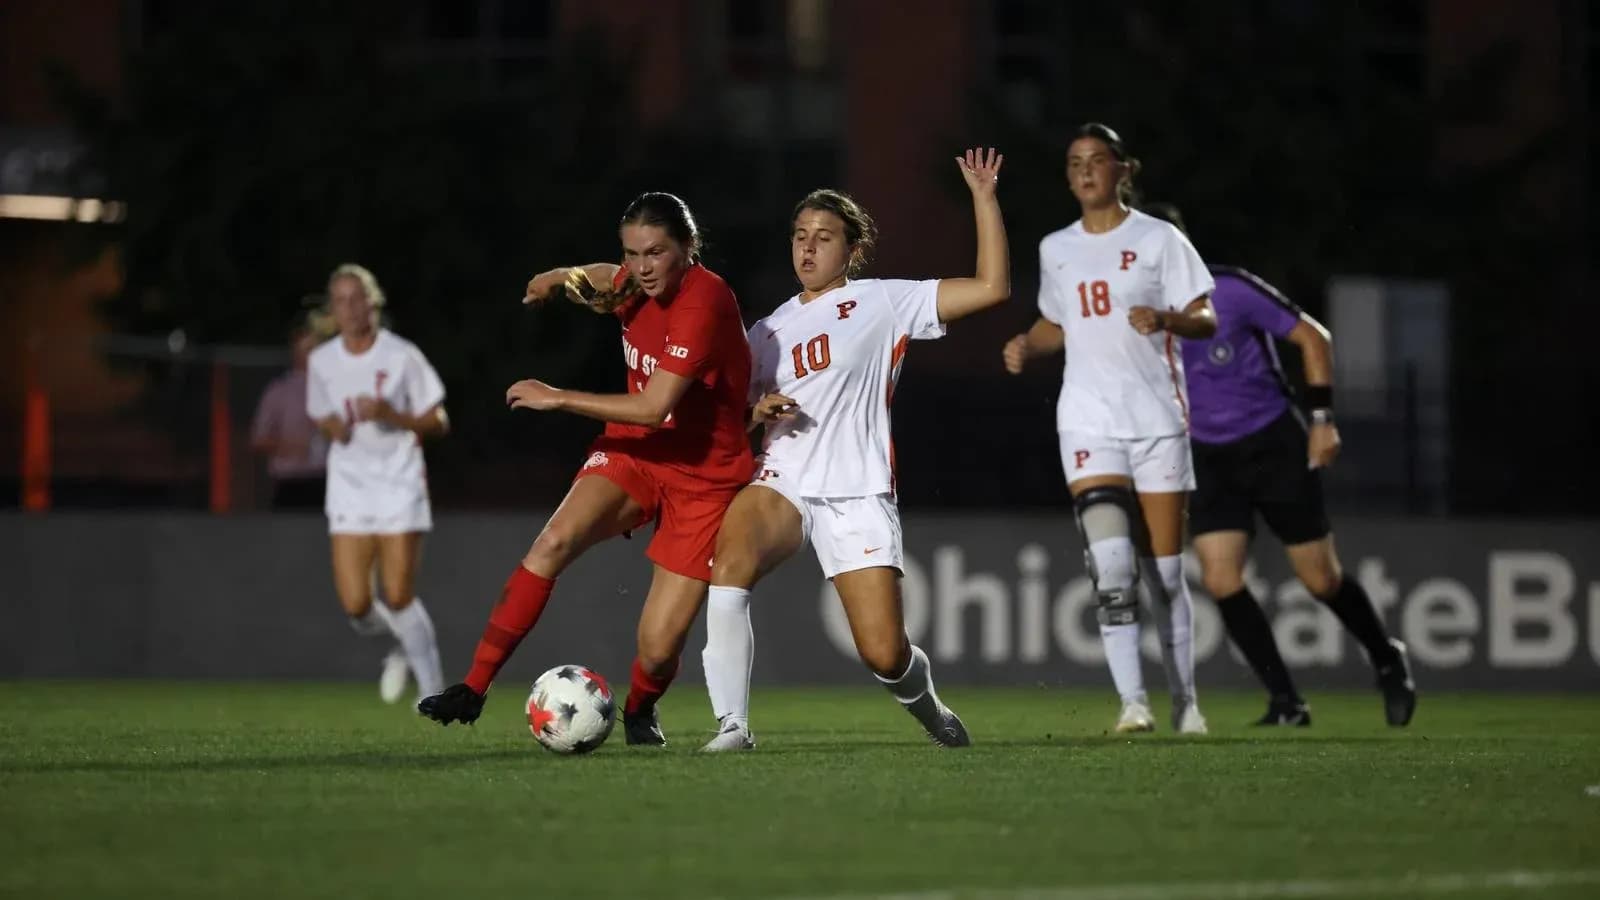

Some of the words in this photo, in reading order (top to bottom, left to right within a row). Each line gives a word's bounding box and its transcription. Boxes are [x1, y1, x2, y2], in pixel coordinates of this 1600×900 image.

[1120, 250, 1137, 271] P
[1078, 280, 1111, 318] 18
[836, 300, 857, 321] P
[791, 333, 831, 379] 10
[1074, 449, 1090, 469] P
